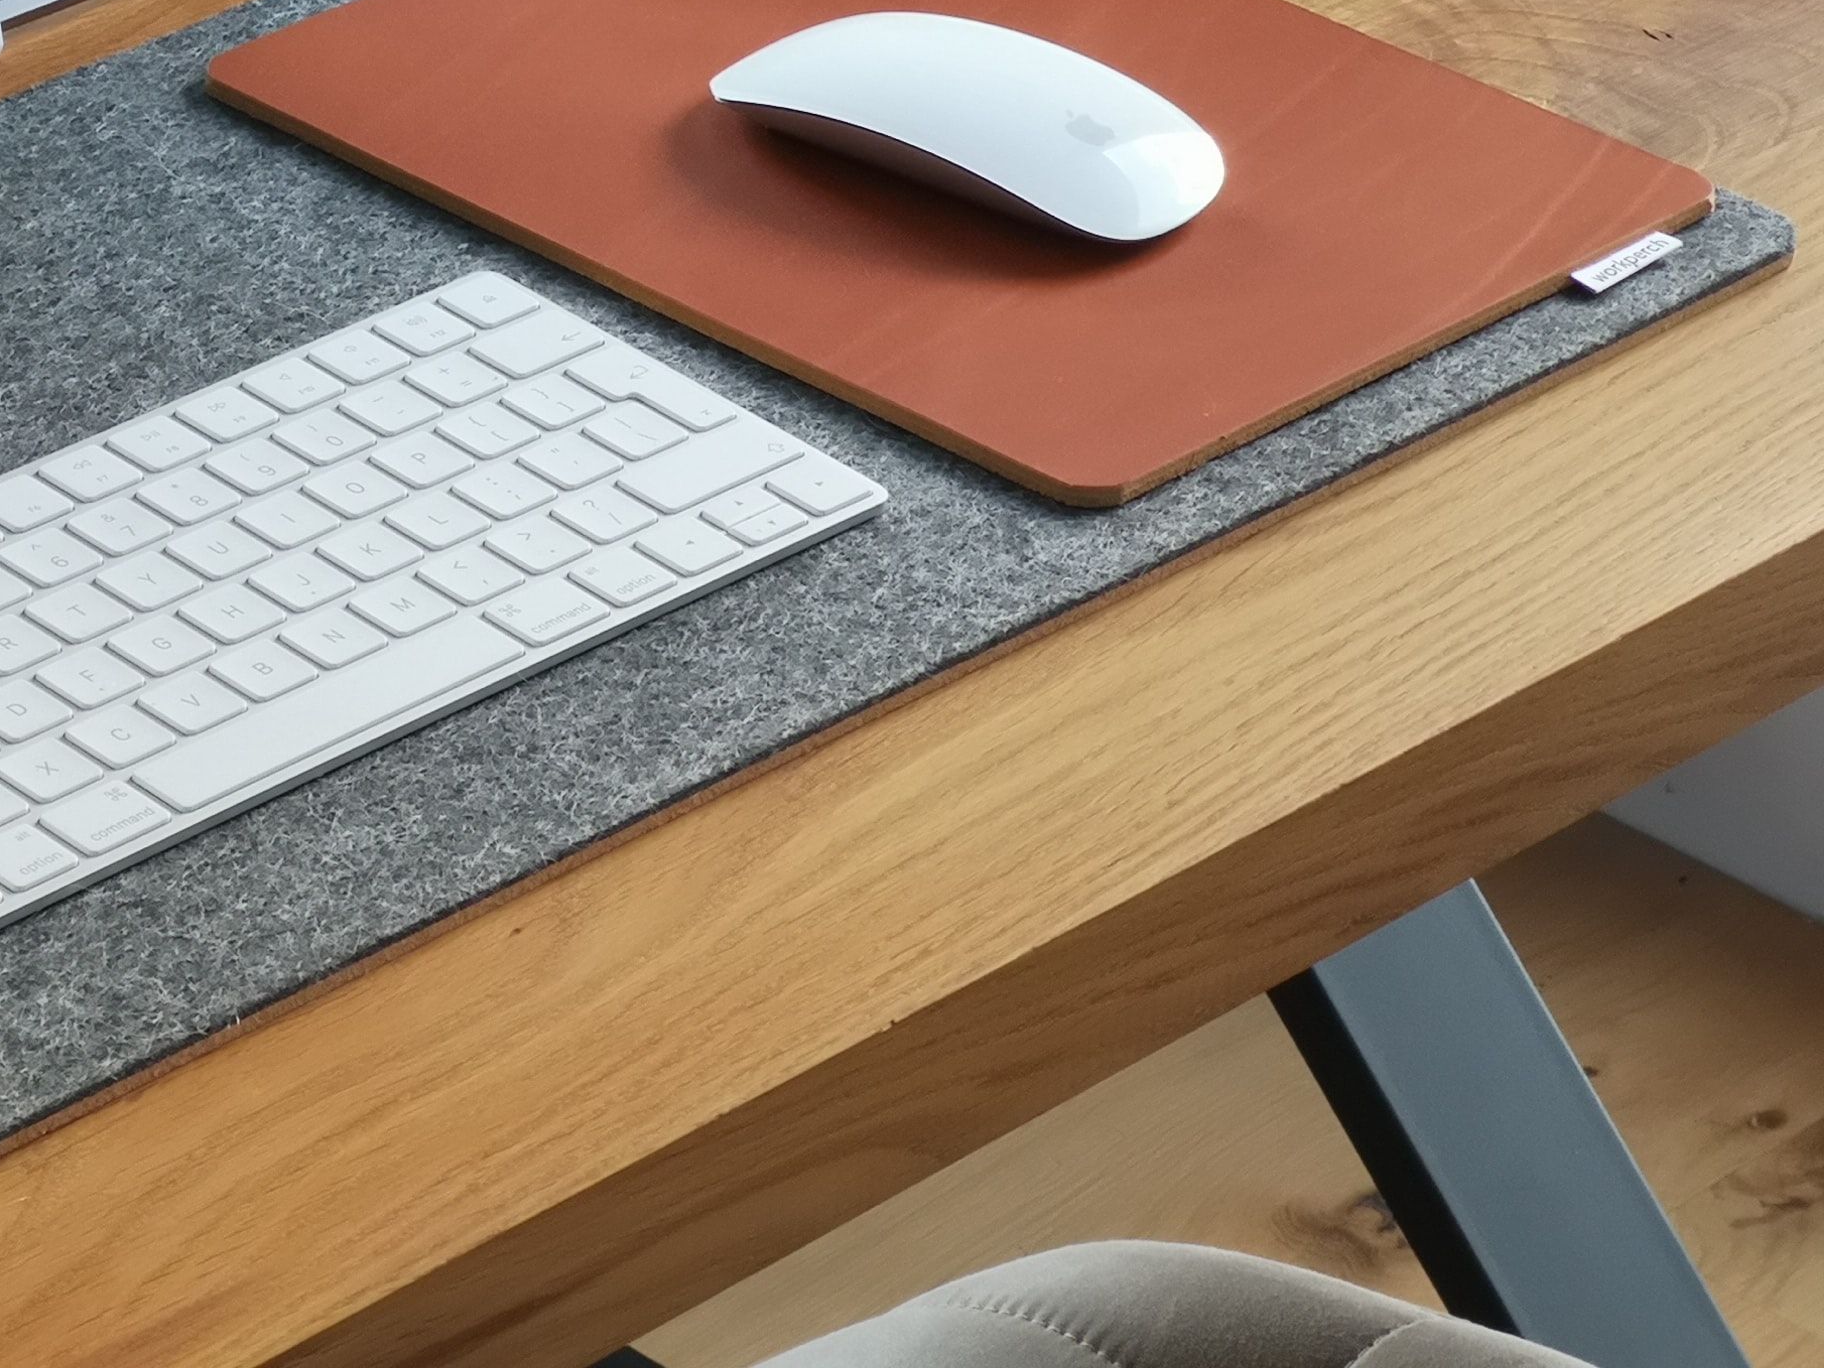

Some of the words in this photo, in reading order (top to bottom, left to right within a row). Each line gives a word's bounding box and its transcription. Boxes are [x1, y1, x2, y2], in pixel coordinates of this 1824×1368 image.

[1593, 238, 1669, 283] workperch
[326, 436, 343, 446] 0
[411, 453, 426, 464] P
[258, 466, 276, 476] 9
[346, 483, 364, 493] O
[190, 496, 208, 506] 8
[101, 514, 116, 522] &
[428, 516, 448, 524] L
[120, 525, 135, 536] 7
[208, 541, 229, 554] U
[360, 543, 381, 556] K
[51, 556, 69, 567] 6
[138, 573, 156, 584] Y
[297, 574, 310, 586] J
[616, 574, 655, 595] option
[67, 604, 86, 616] T
[390, 598, 415, 612] M
[221, 605, 244, 618] H
[532, 603, 592, 635] command
[322, 630, 346, 643] N
[152, 638, 172, 649] G
[252, 663, 273, 675] B
[79, 670, 94, 682] F
[181, 694, 200, 706] V
[6, 704, 27, 716] D
[110, 728, 131, 740] C
[36, 762, 59, 776] X
[90, 807, 155, 842] command
[19, 852, 63, 879] option
